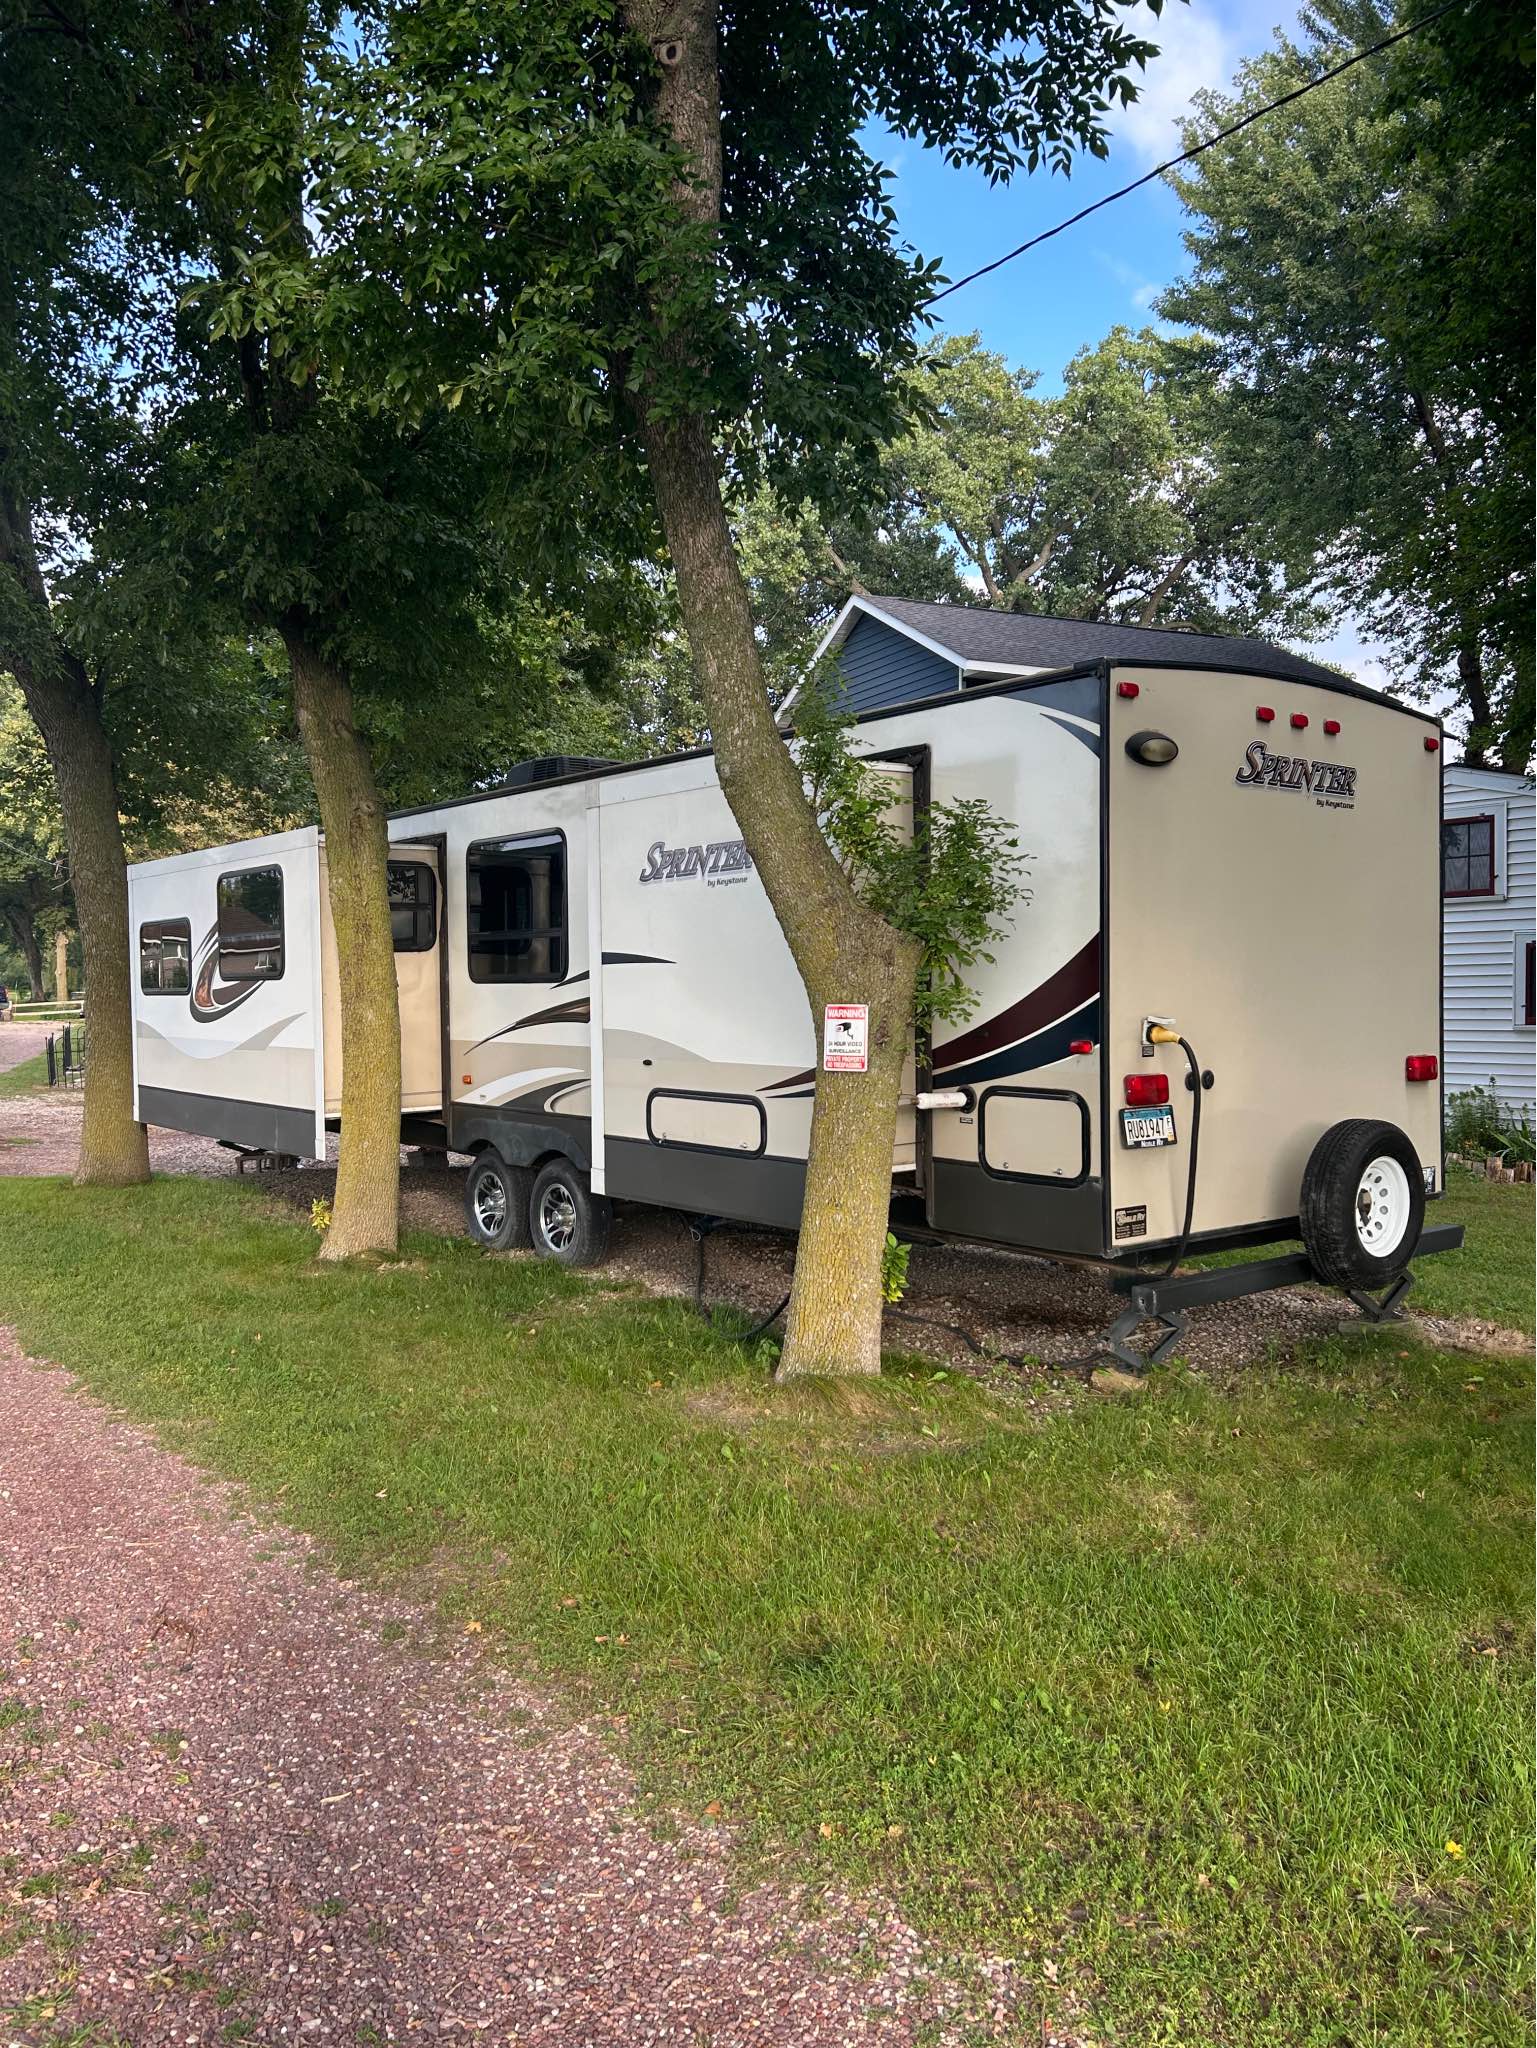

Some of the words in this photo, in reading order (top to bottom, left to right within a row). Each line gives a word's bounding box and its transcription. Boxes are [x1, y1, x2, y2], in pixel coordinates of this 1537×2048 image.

[1236, 740, 1357, 797] SPRINTER
[1316, 798, 1324, 807] by
[1325, 799, 1355, 809] Keystone
[707, 879, 716, 888] by
[716, 877, 748, 887] Keystone
[828, 1008, 865, 1018] WARNING
[1127, 1117, 1164, 1139] RU81947
